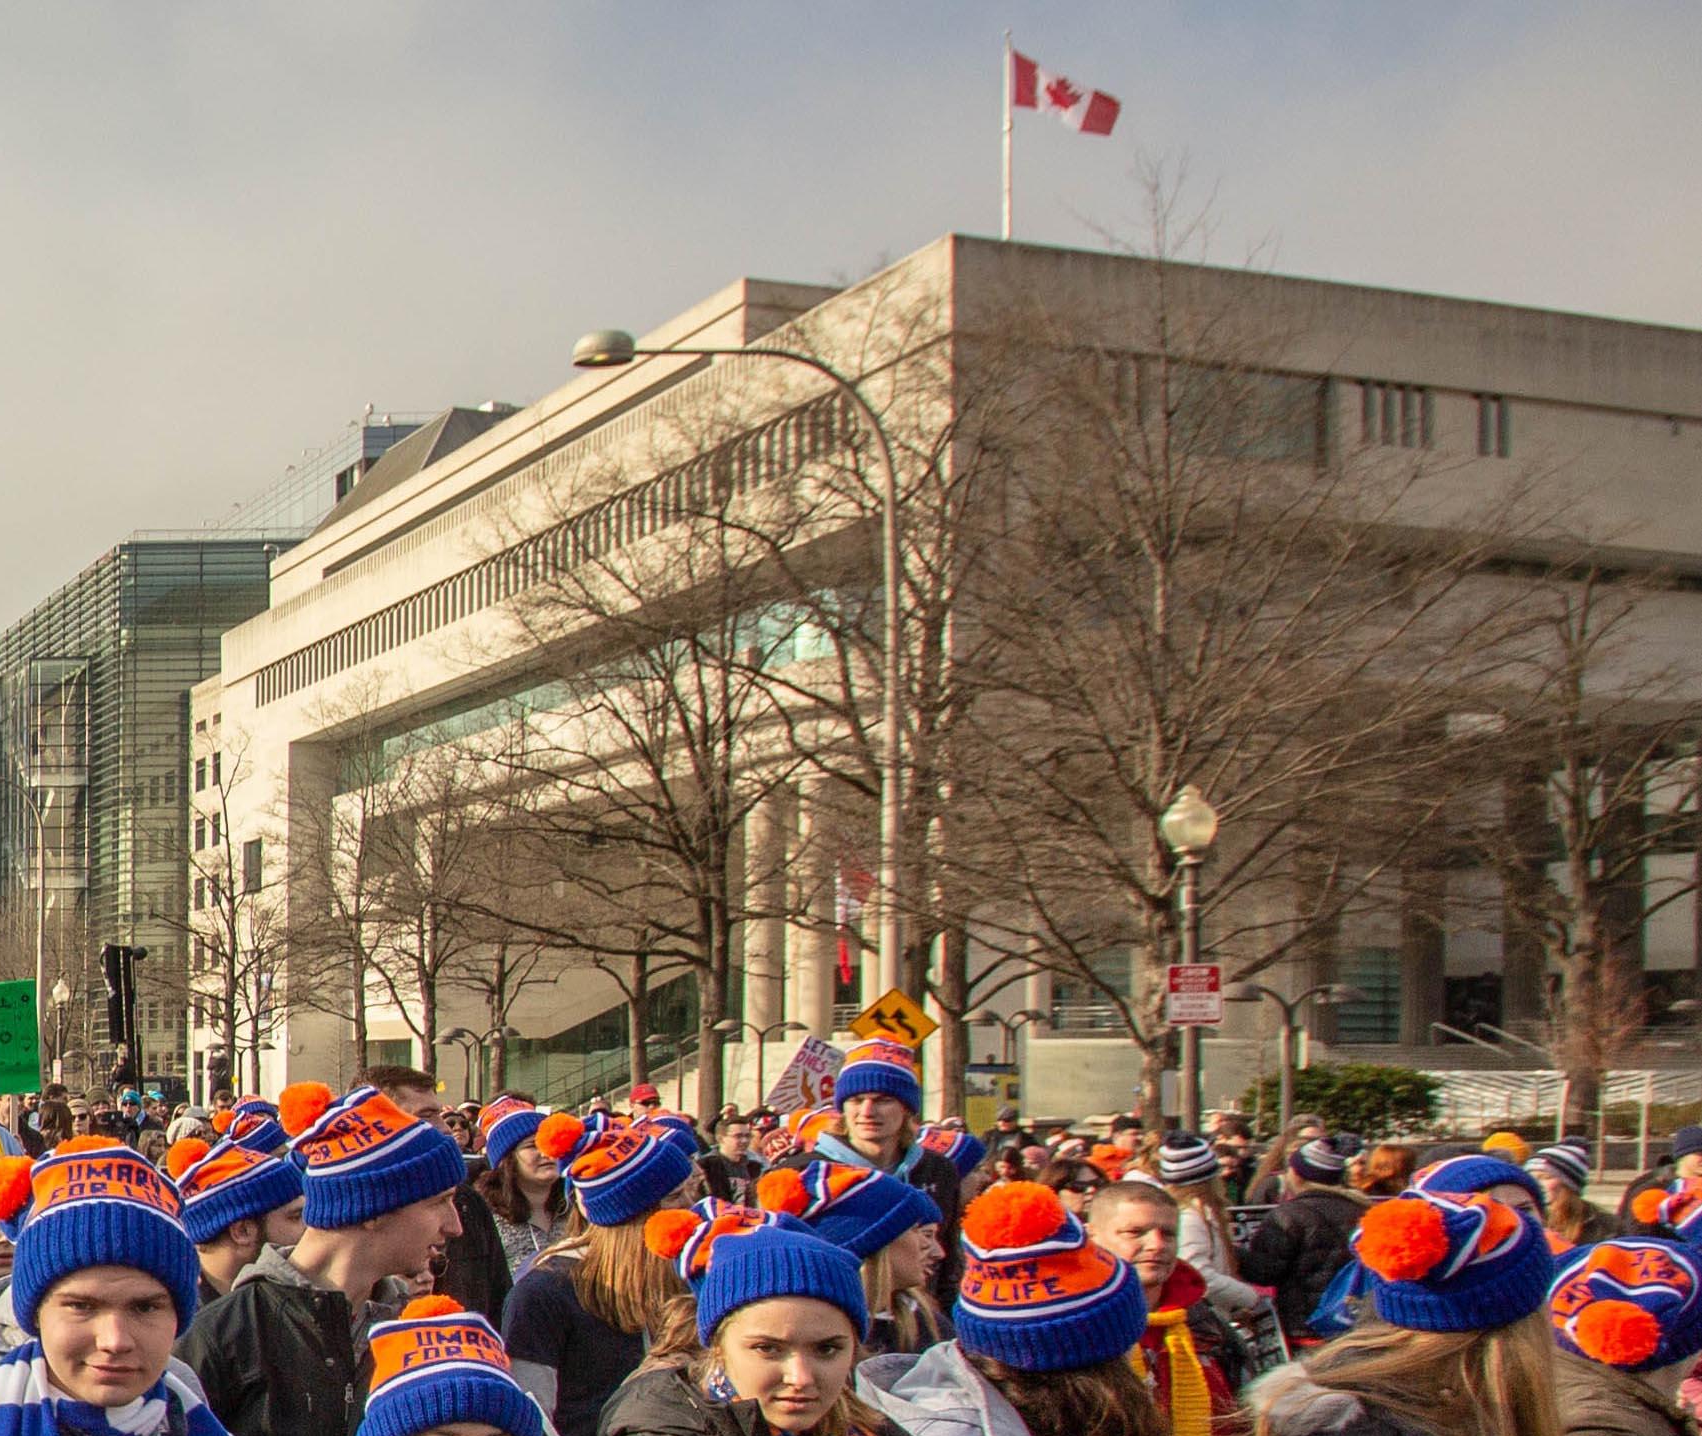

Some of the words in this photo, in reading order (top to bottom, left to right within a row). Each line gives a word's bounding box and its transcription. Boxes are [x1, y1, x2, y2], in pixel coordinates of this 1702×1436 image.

[338, 1119, 394, 1154] LIFE
[50, 1180, 105, 1204] FOR
[65, 1163, 162, 1207] UMARY
[991, 1276, 1066, 1303] LIFE
[402, 1345, 464, 1370] FOR
